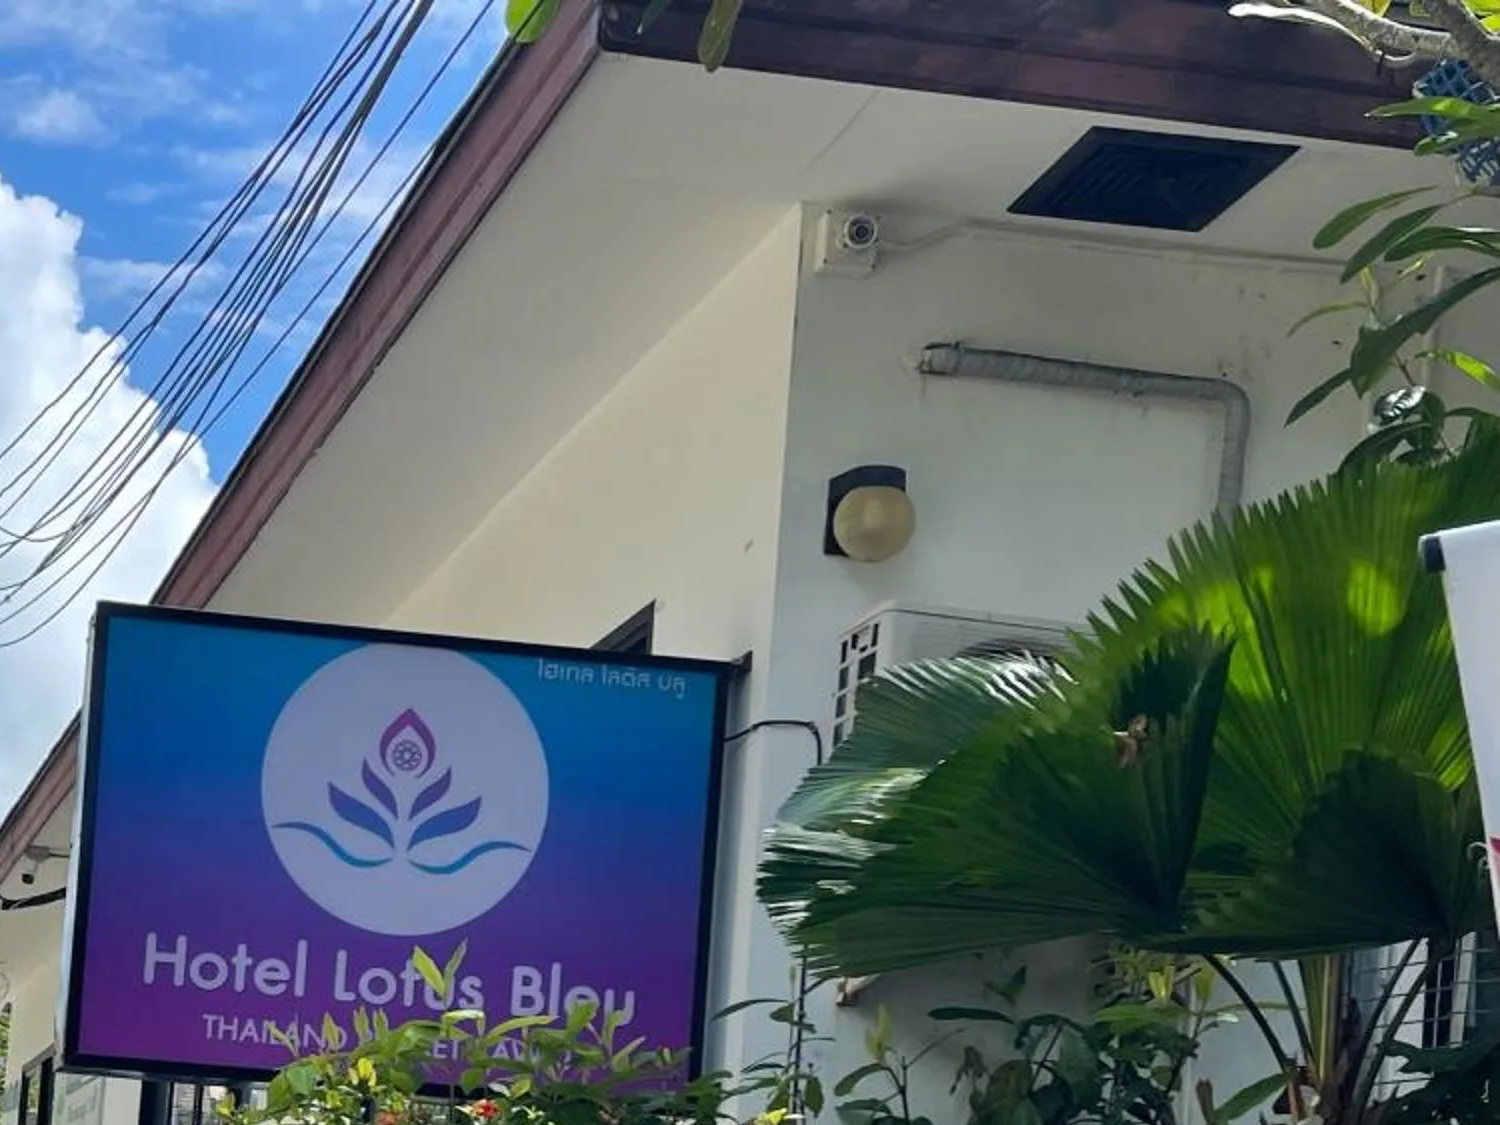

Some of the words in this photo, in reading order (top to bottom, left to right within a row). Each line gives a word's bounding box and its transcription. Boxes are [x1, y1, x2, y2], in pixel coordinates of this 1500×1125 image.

[537, 657, 594, 684] โฮเทล
[602, 664, 650, 688] โลตัส
[657, 672, 686, 699] บลู
[143, 932, 308, 996] Hotel
[334, 950, 484, 1011] Lotus
